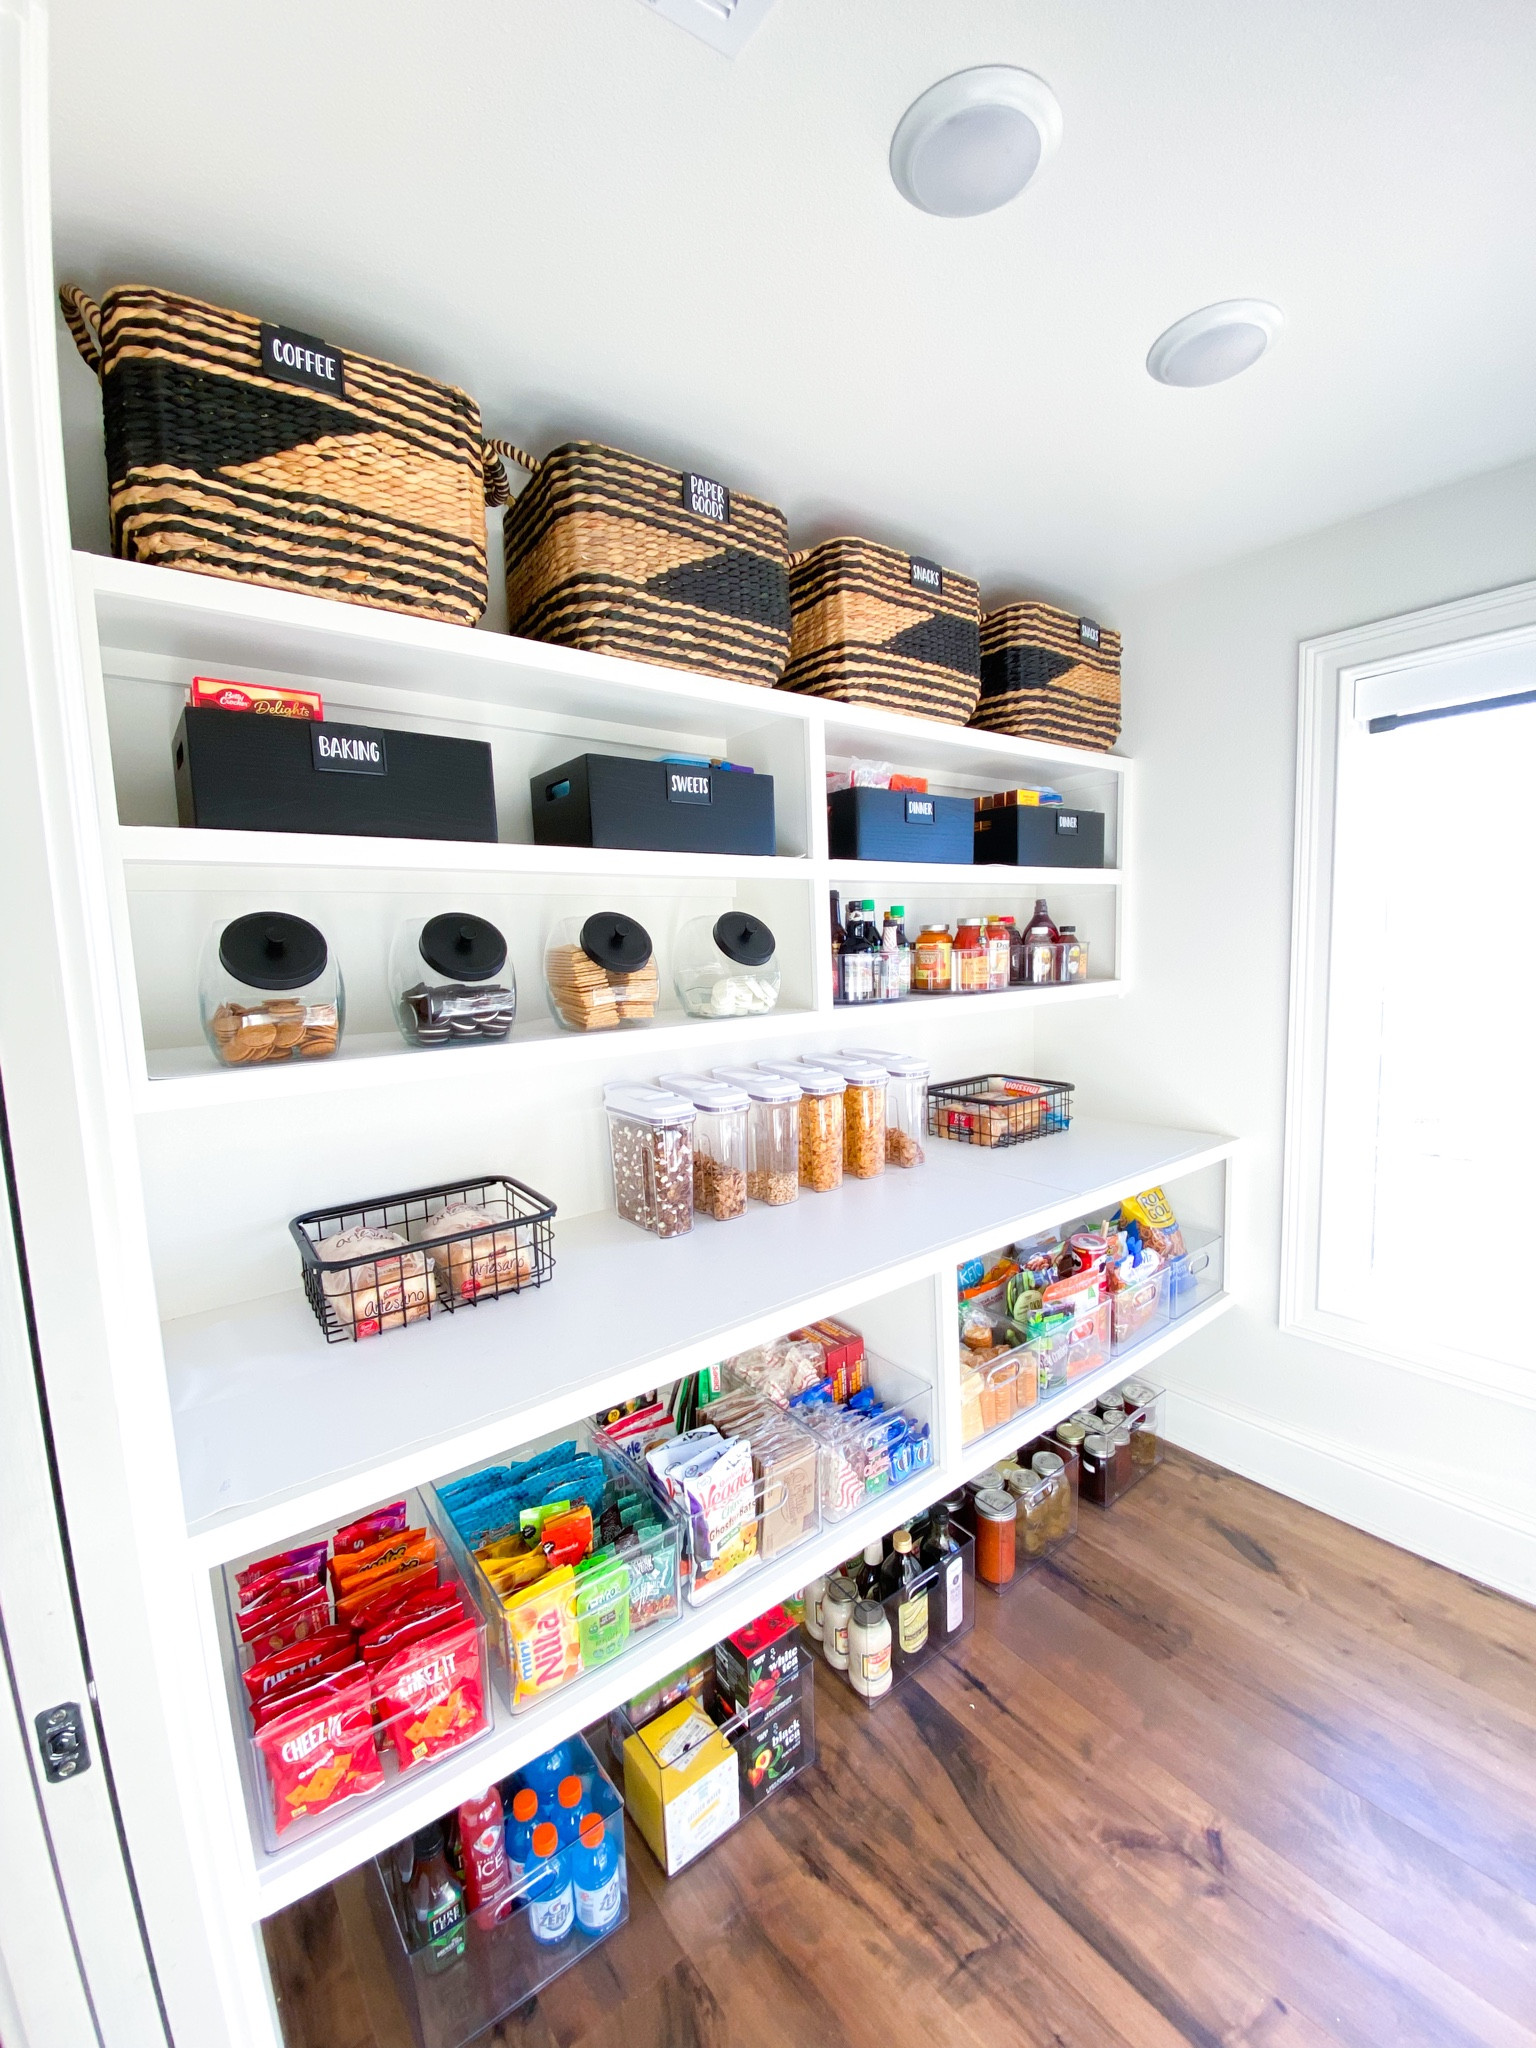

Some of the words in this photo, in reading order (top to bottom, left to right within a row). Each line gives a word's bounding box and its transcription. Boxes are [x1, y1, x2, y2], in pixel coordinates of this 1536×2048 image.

[273, 338, 336, 381] COFFEE
[690, 475, 725, 505] PAPER
[691, 493, 724, 521] GOODS
[912, 564, 939, 586] SNACKS
[219, 696, 249, 708] Crocker
[225, 690, 244, 702] Betty
[253, 700, 310, 718] Delights
[318, 735, 380, 762] BAKING
[671, 774, 709, 794] SWEETS
[908, 801, 933, 816] DINNER
[1059, 815, 1077, 828] DINNER
[1148, 1202, 1171, 1220] GOL
[699, 1465, 753, 1519] Veggie
[532, 1608, 564, 1687] Nilla
[768, 1646, 798, 1672] white
[518, 1640, 532, 1681] mini
[782, 1656, 799, 1674] tea
[771, 1718, 800, 1747] black
[784, 1729, 800, 1746] tea
[476, 1855, 504, 1880] ICE
[432, 1904, 460, 1927] PURE
[540, 1904, 571, 1930] ZERO
